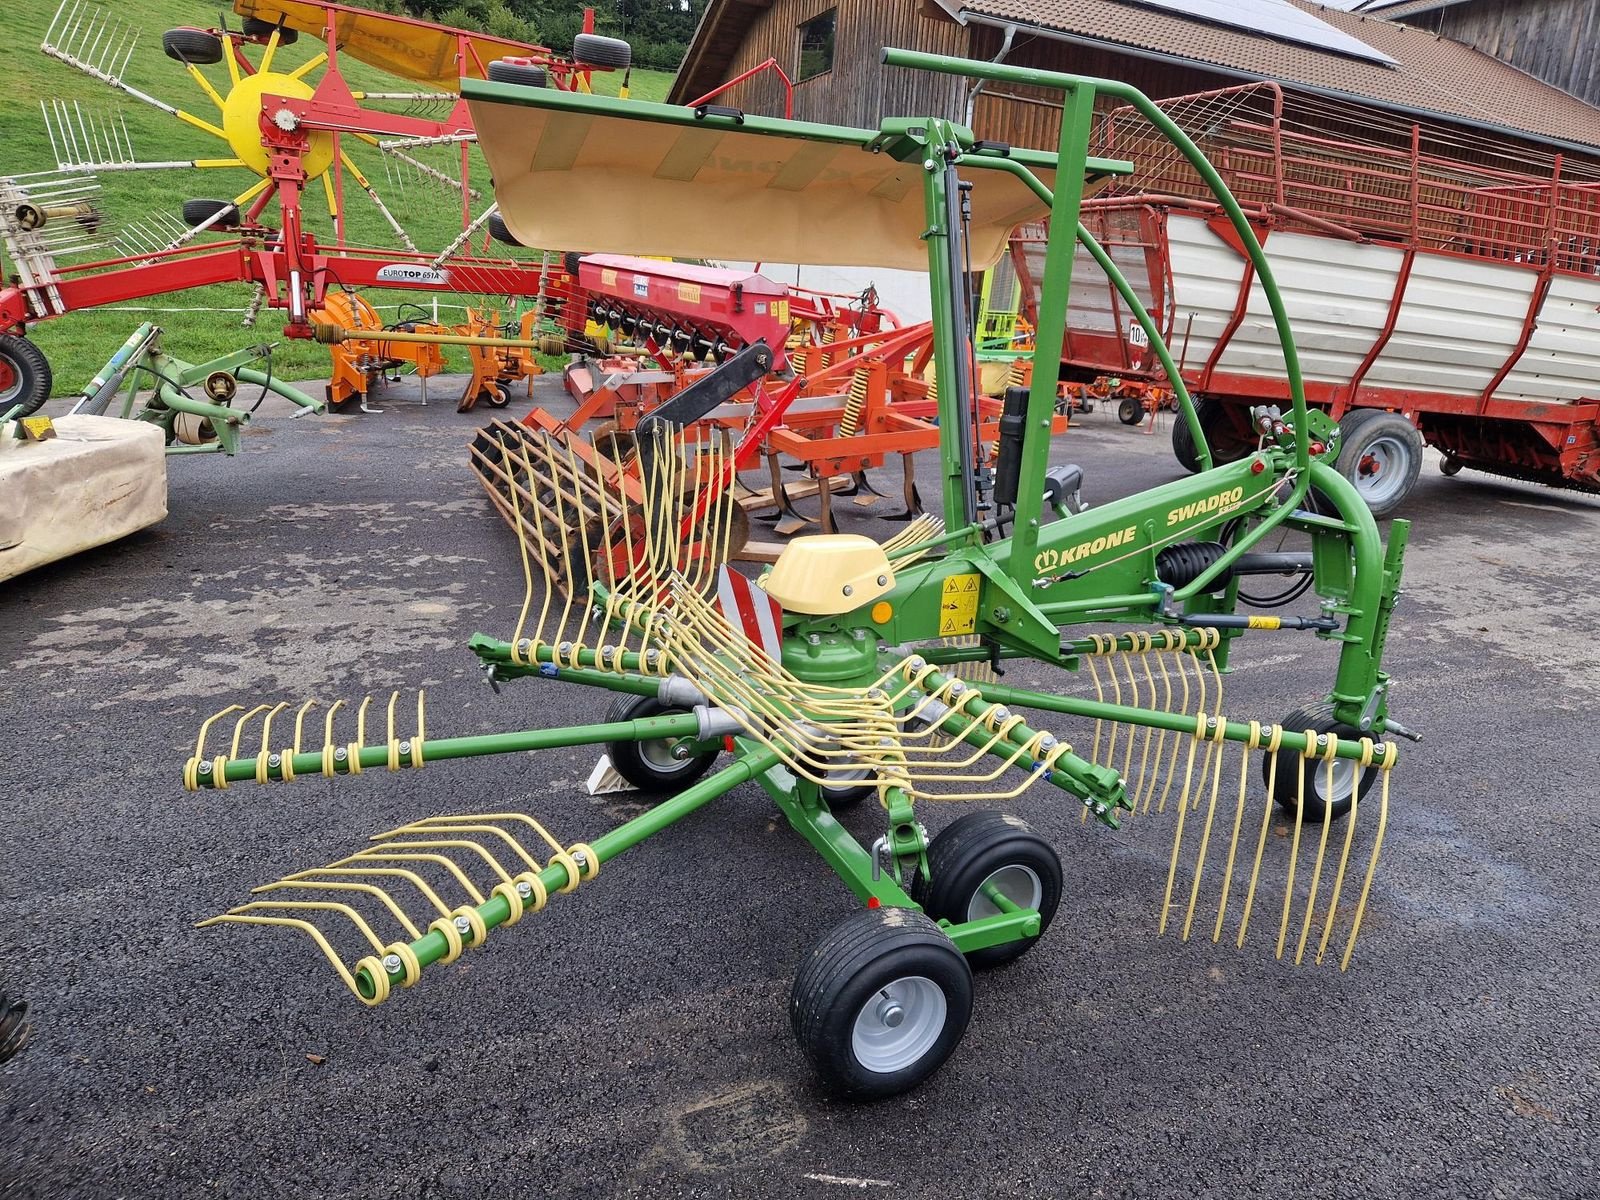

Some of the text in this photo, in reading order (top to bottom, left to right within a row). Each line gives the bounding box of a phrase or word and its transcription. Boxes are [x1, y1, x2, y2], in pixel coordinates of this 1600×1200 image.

[383, 269, 421, 278] EUROTOP
[1131, 326, 1140, 343] 10
[1167, 486, 1243, 526] SWADRO
[1060, 525, 1137, 567] KRONE
